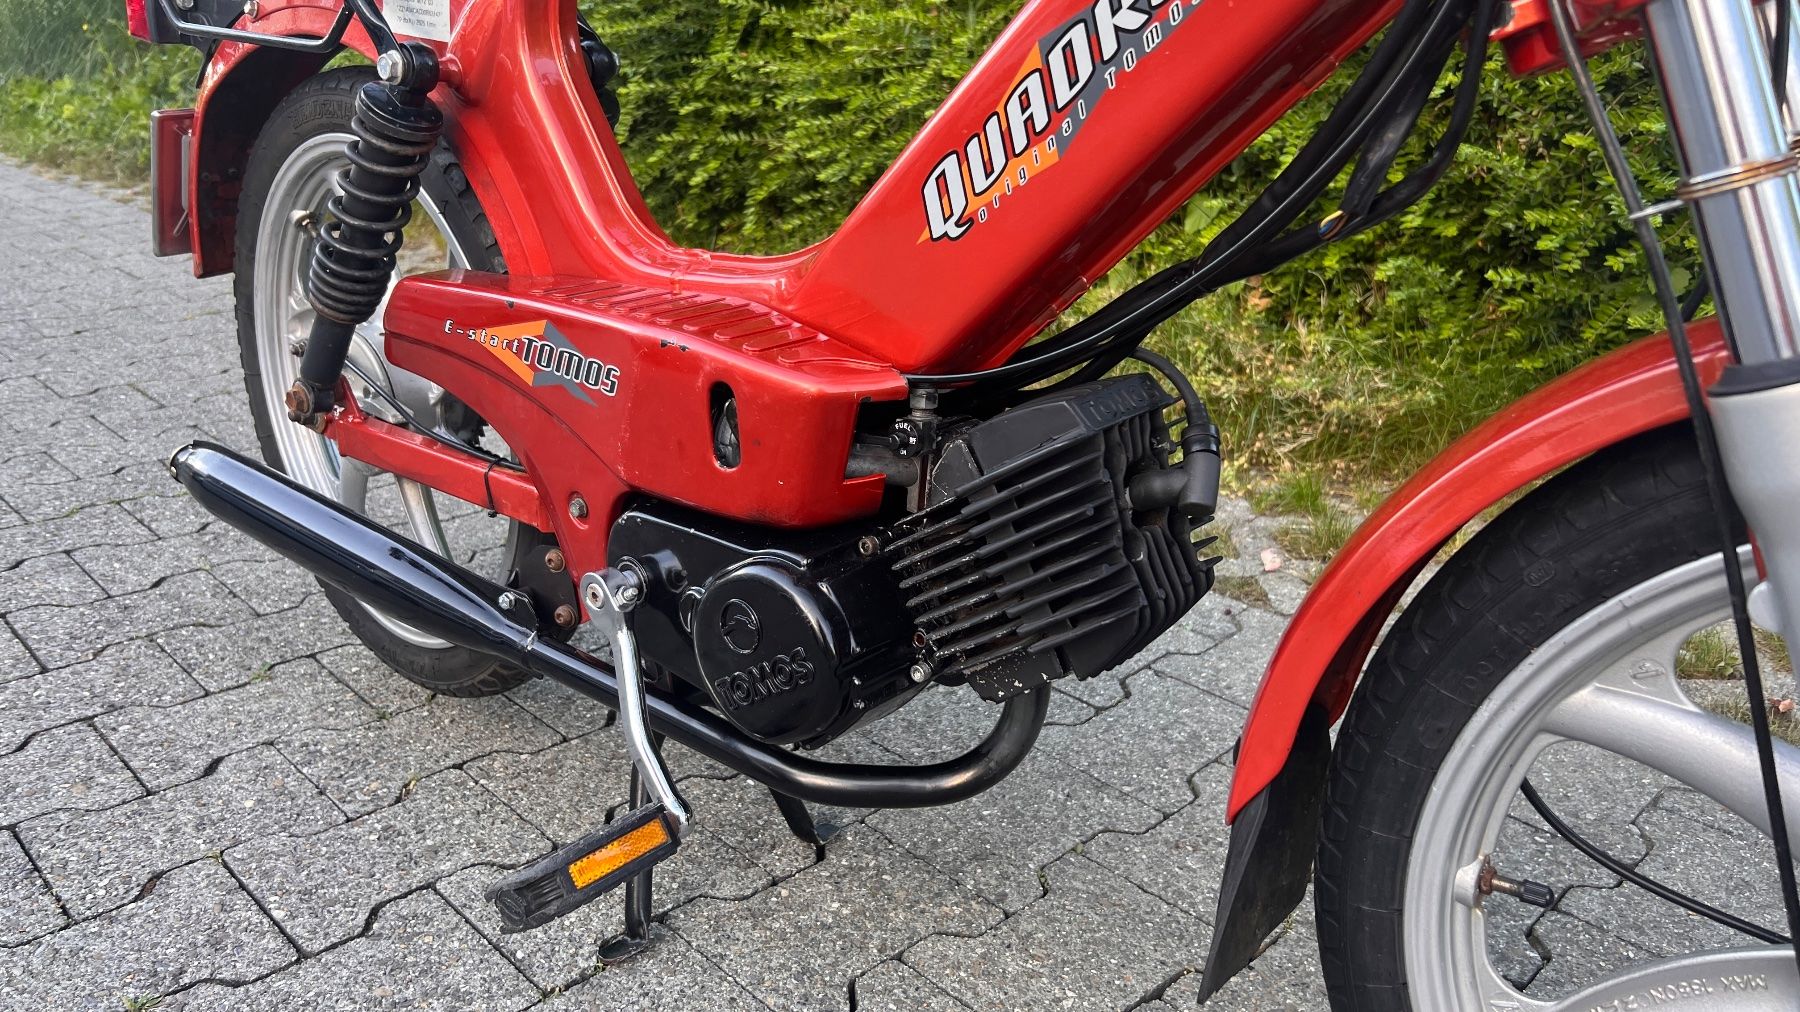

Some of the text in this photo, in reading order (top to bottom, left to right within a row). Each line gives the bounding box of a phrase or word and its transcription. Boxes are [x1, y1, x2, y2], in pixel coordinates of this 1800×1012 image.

[921, 0, 1172, 241] QUADR
[977, 97, 1088, 224] original
[444, 319, 621, 397] E-start TOMOS
[894, 421, 912, 432] FUEL
[714, 646, 815, 710] TOMOS
[1720, 974, 1769, 992] MAX
